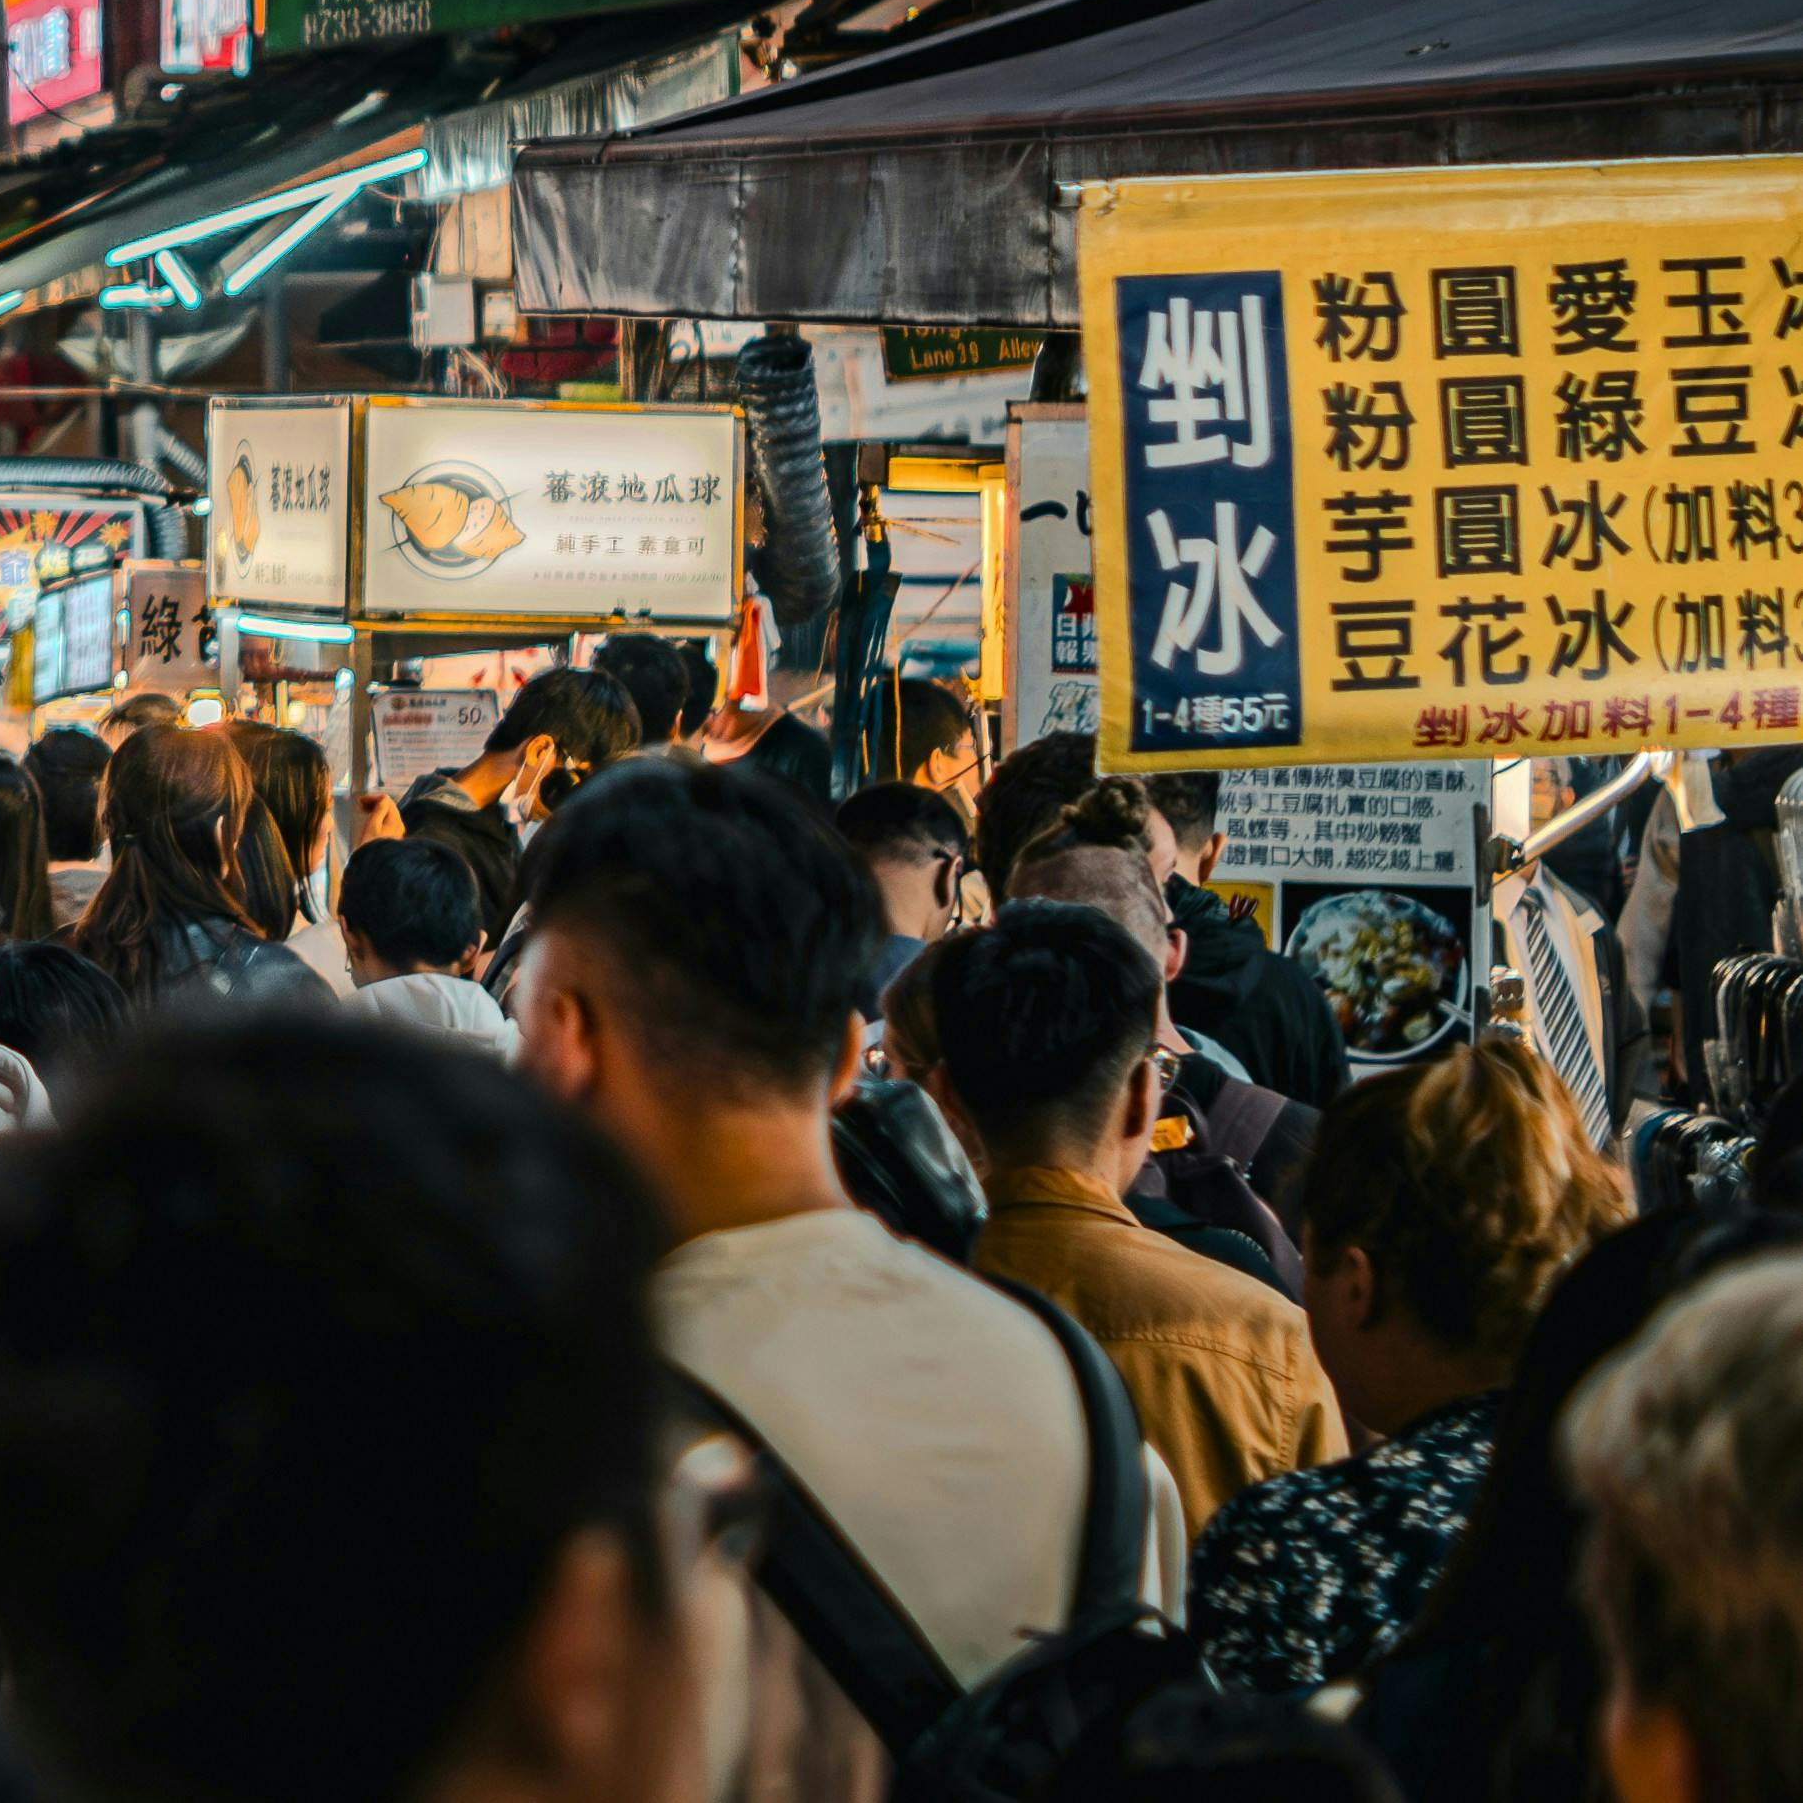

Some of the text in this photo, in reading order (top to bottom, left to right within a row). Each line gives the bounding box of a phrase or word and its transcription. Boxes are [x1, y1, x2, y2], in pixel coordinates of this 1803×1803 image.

[910, 347, 955, 370] Lane
[1137, 292, 1286, 677] 剉冰
[1328, 587, 1803, 694] 豆花冰(加料
